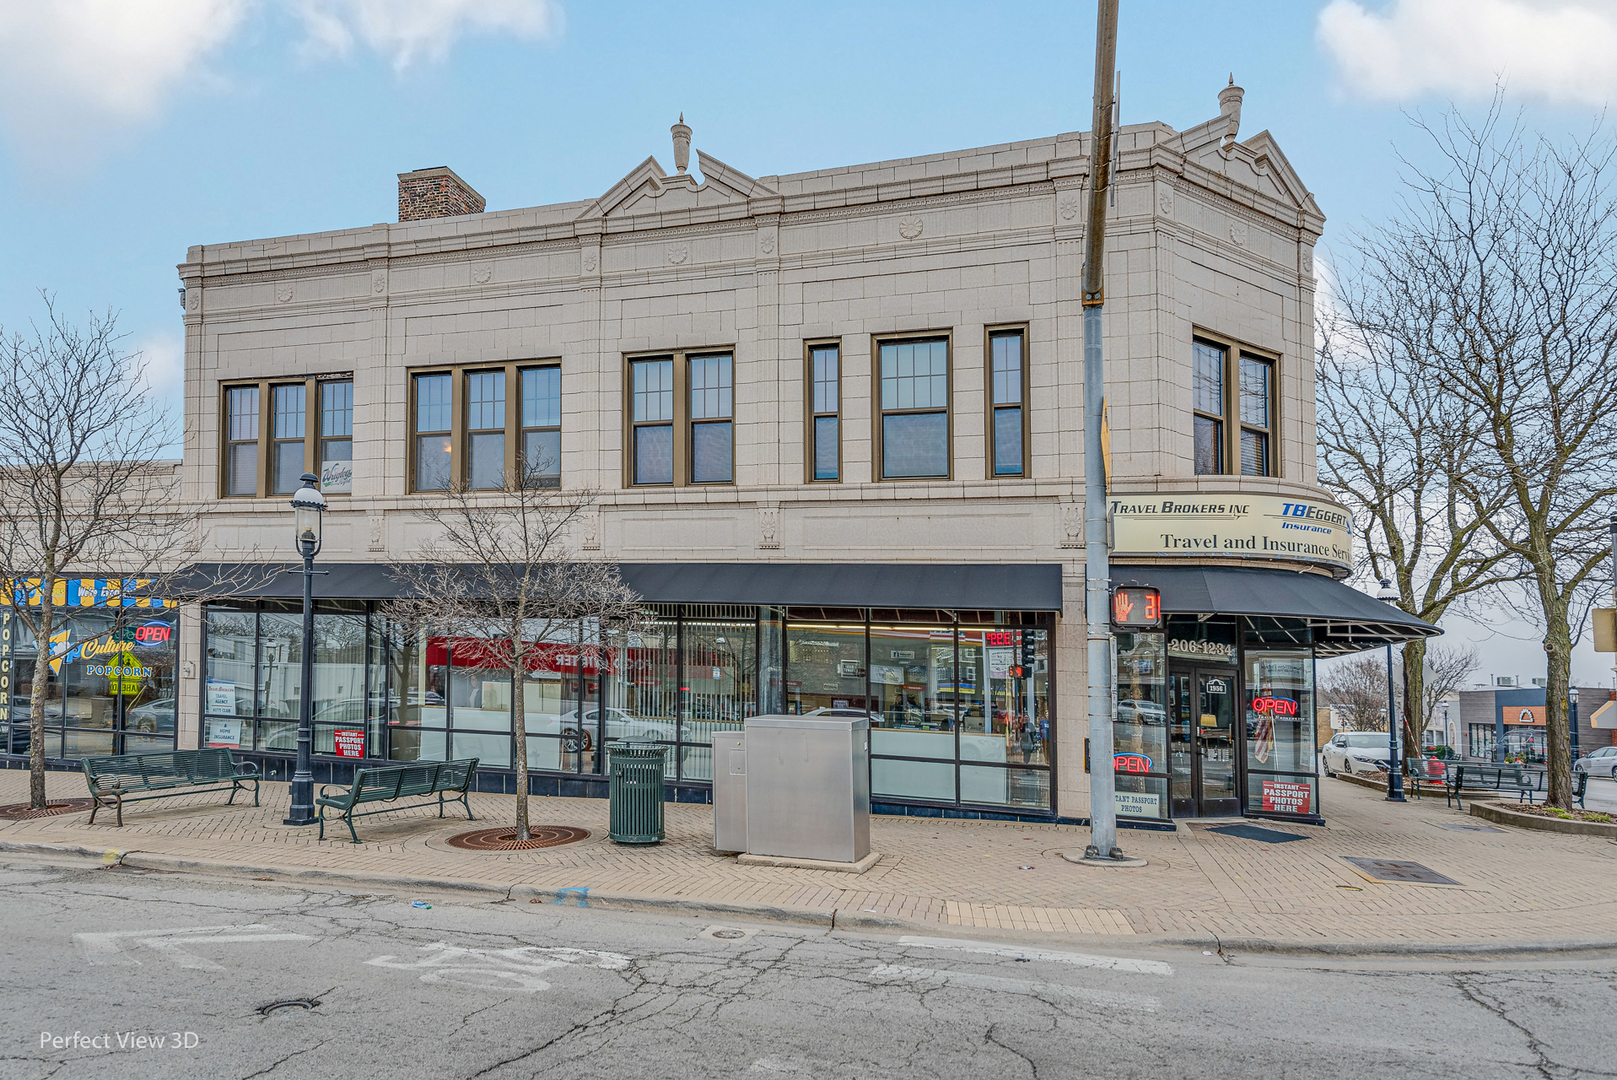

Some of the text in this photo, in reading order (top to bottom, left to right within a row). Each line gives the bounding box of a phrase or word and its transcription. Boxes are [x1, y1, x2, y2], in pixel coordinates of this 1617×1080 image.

[1111, 501, 1250, 514] TRAVEL BROKERS INC
[1281, 521, 1332, 535] Insurance
[1160, 534, 1353, 563] Travel and Insurance Servi
[135, 626, 172, 642] OPEN
[81, 635, 135, 660] Culture
[0, 612, 11, 721] POPCORN
[86, 664, 153, 678] POPCORN
[1252, 698, 1296, 715] OPEN
[1264, 788, 1310, 799] PASSPORT
[1131, 797, 1158, 805] PASSPORT
[1270, 797, 1303, 806] PHOTOS
[1121, 805, 1143, 813] PHOTOS
[1274, 804, 1298, 813] HERE
